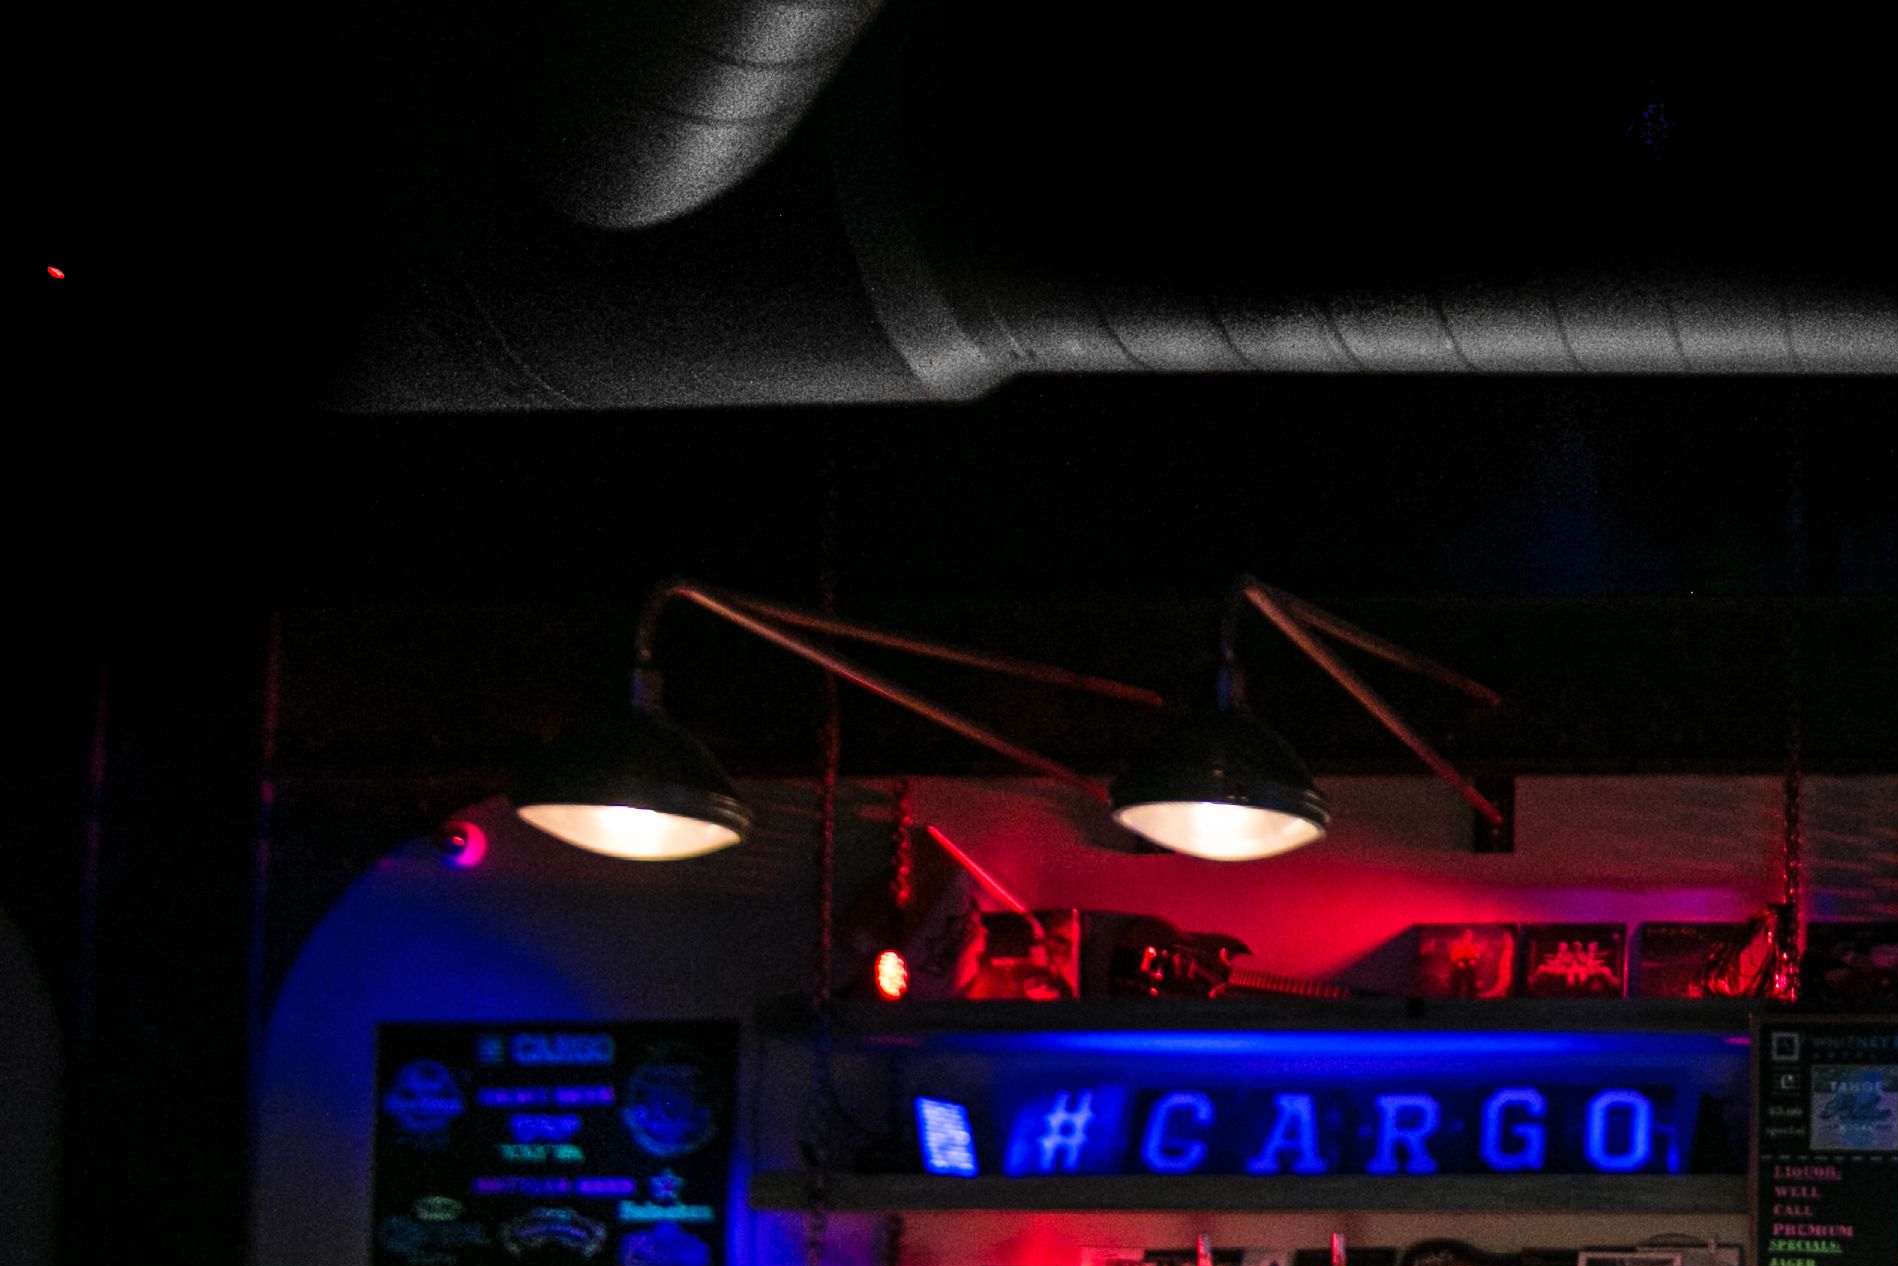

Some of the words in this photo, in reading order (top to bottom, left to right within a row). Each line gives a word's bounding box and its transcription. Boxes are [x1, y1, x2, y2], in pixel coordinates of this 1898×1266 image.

[1812, 1036, 1889, 1049] WHITNEY
[1829, 1080, 1883, 1092] TAHOE
[1774, 1186, 1821, 1199] WELL
[1773, 1204, 1814, 1218] CALL
[1772, 1222, 1854, 1238] PREMIUM
